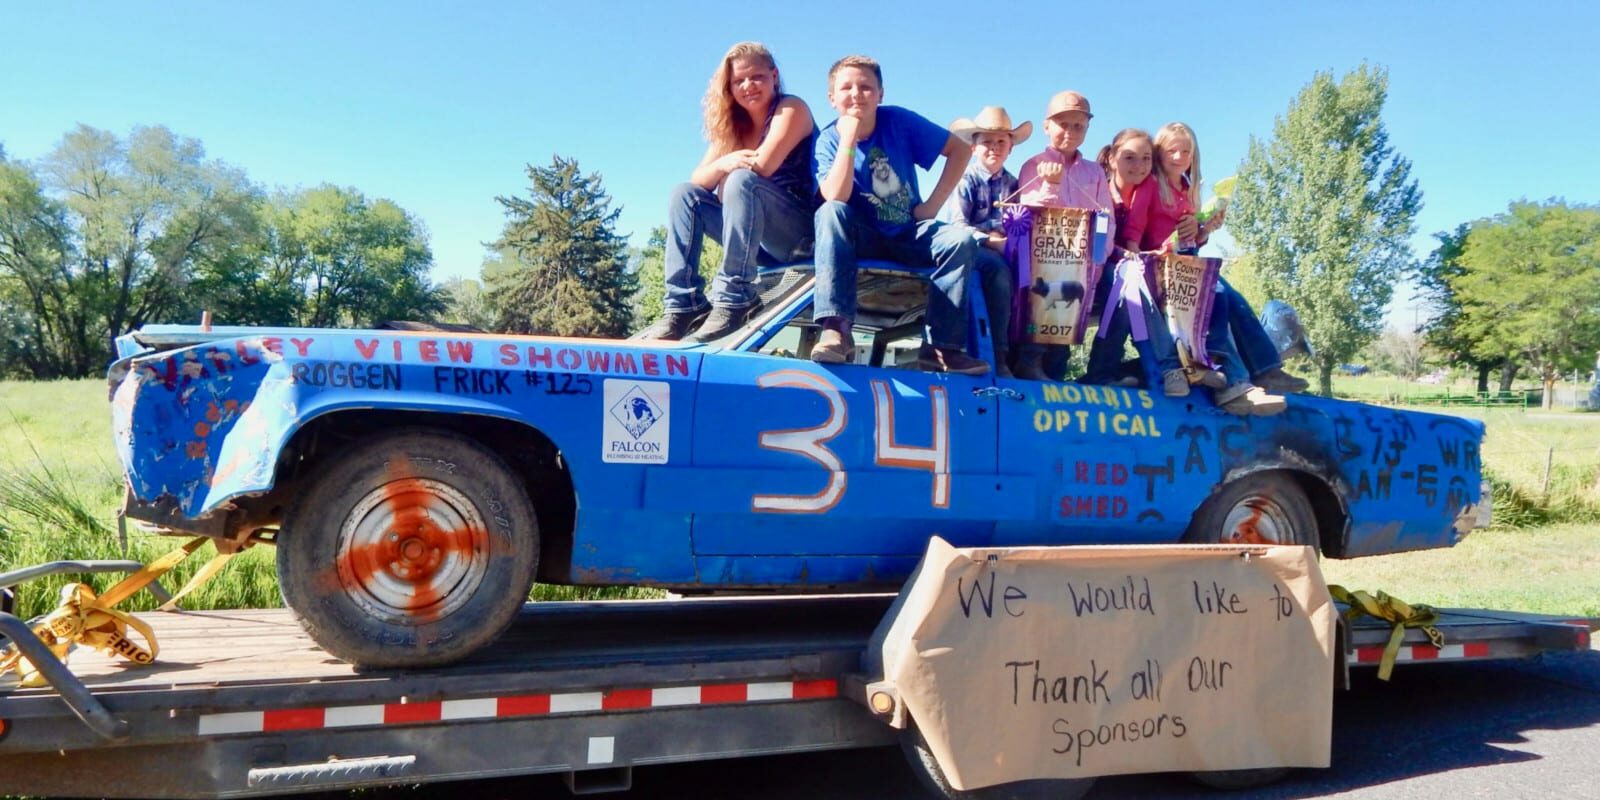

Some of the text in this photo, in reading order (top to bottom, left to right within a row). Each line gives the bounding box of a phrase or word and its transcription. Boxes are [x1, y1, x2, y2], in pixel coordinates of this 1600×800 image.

[1033, 248, 1087, 260] CHAMPION
[1035, 236, 1088, 250] GRAND
[1040, 325, 1072, 336] 2017
[354, 338, 473, 363] VIEW
[498, 344, 690, 377] SHOWMEN
[291, 361, 593, 395] ROGGEN FRICK #125
[1042, 384, 1154, 410] MORRIS
[1033, 409, 1161, 437] OPTICAL
[611, 441, 661, 453] FALCON
[751, 369, 951, 514] 34
[1075, 460, 1129, 486] RED
[1058, 495, 1129, 518] SHED
[957, 571, 1026, 619] We
[1193, 579, 1249, 615] like
[1270, 584, 1294, 621] to
[1005, 656, 1233, 706] Thank all Our
[1051, 713, 1187, 767] Sponsors
